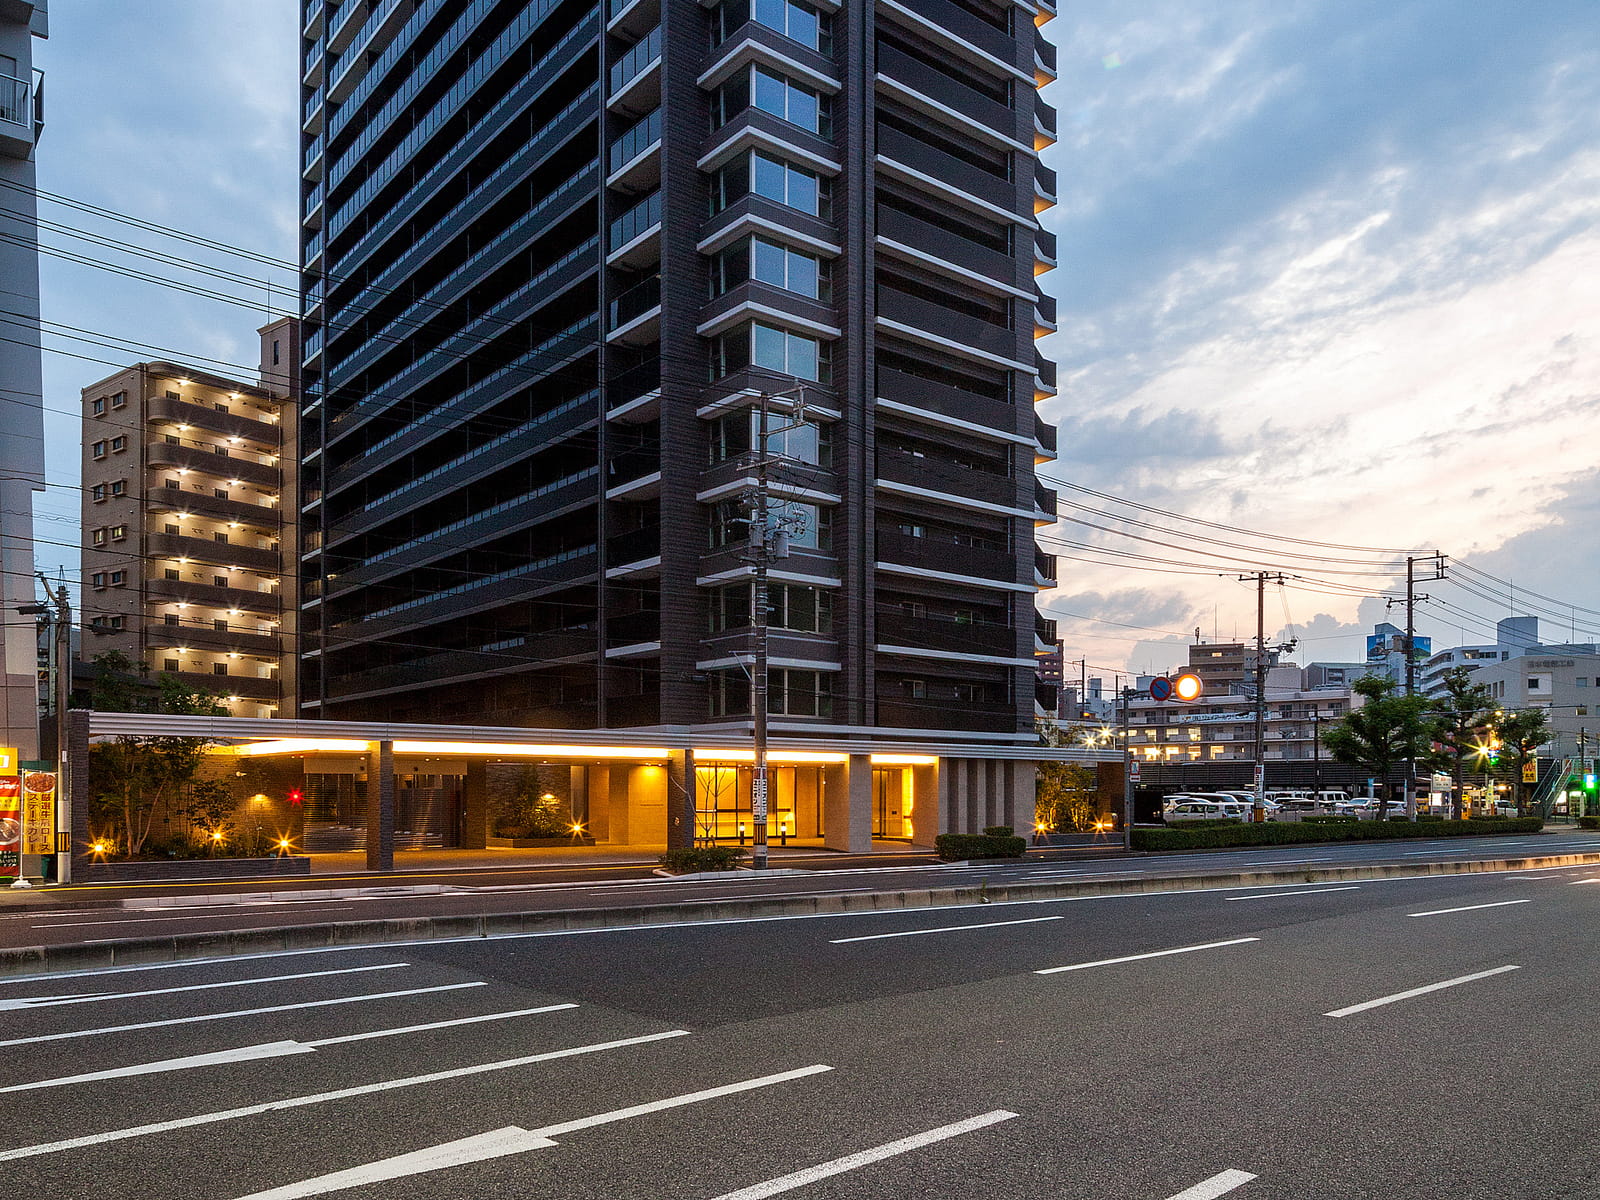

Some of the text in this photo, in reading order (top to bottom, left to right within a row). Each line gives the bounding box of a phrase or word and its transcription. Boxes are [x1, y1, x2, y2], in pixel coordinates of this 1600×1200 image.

[28, 793, 38, 852] ステーキカレー
